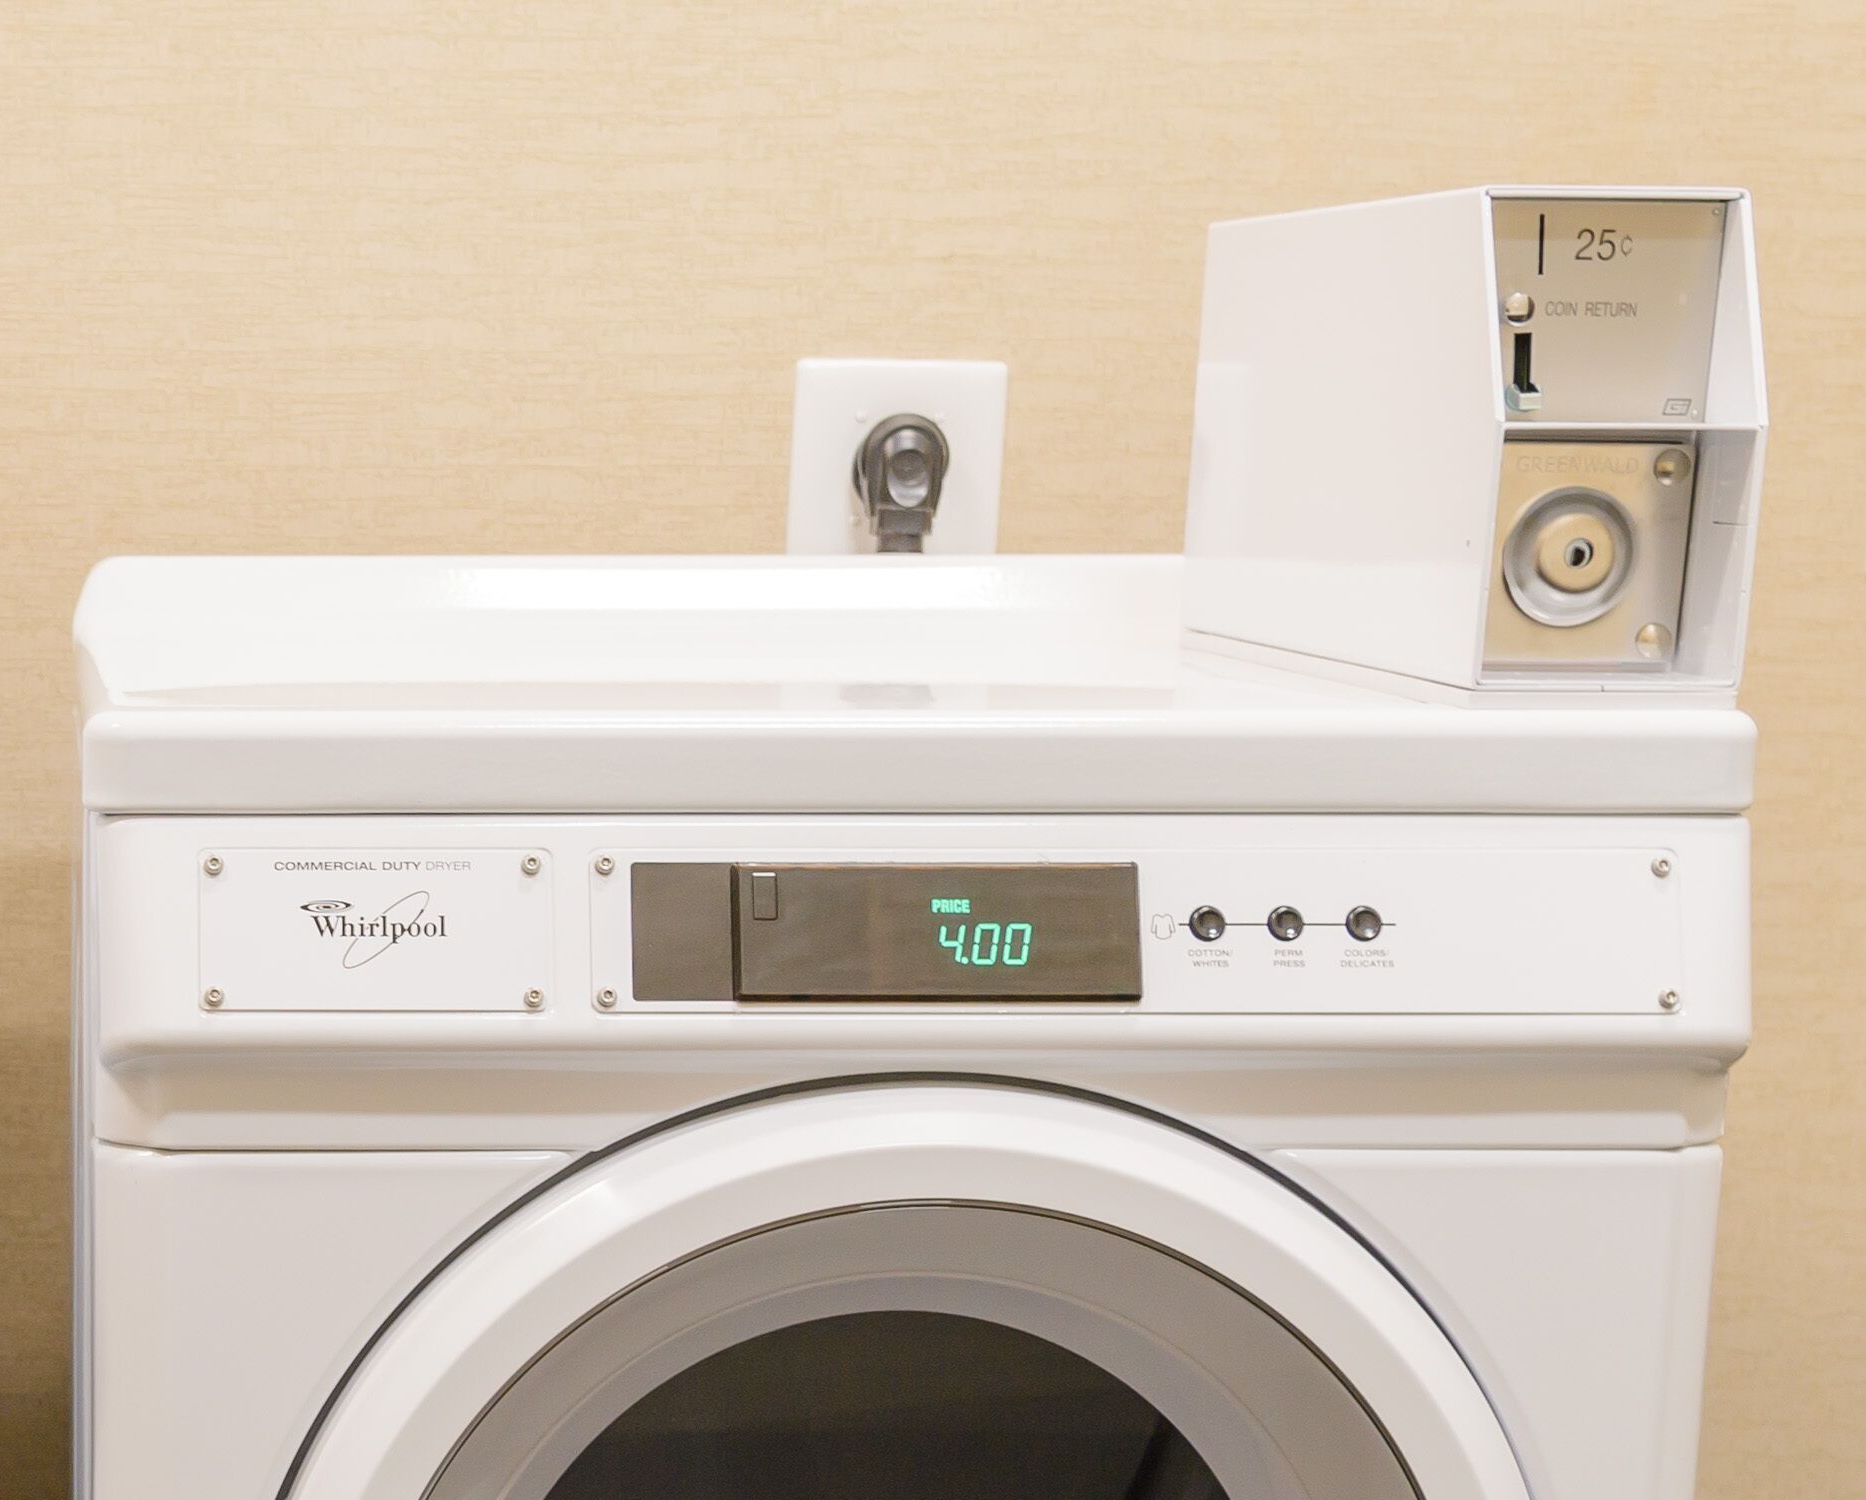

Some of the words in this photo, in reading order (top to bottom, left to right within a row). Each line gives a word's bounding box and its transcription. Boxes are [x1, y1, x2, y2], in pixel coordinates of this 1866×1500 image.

[1545, 301, 1578, 317] COIN
[1584, 301, 1638, 318] RETURN
[274, 860, 377, 871] COMMERCIAL
[382, 860, 422, 871] DUTY
[425, 860, 472, 871] DRYER
[931, 898, 971, 914] PRICE
[310, 914, 449, 944] Whirlpool
[939, 922, 1033, 966] 4.00
[1187, 948, 1233, 958] COTTON/
[1273, 948, 1304, 958] PERM
[1344, 948, 1389, 958] COLORS/
[1192, 959, 1230, 969] WHITES
[1272, 959, 1307, 969] PRESS
[1340, 959, 1395, 969] DELICATES
